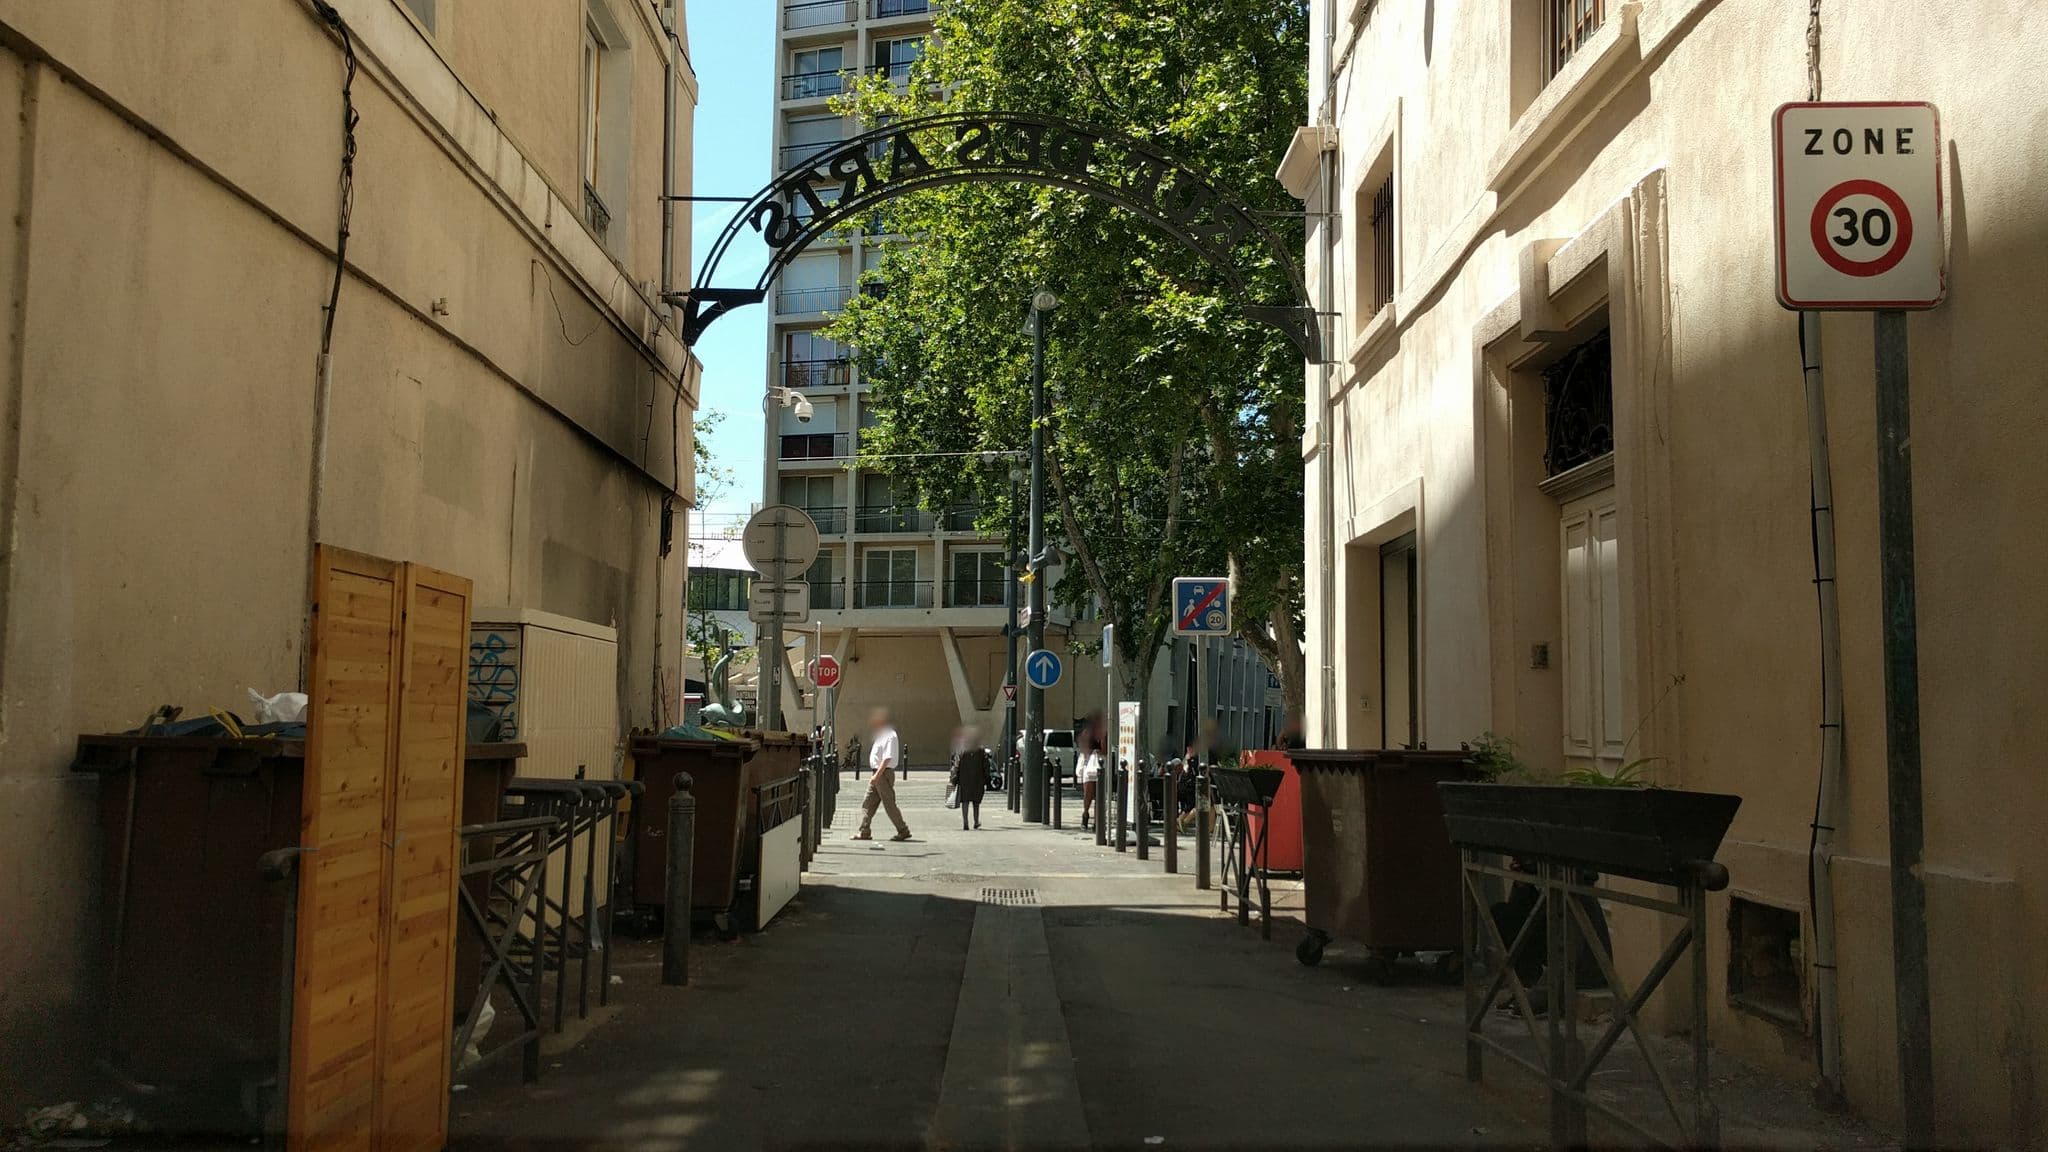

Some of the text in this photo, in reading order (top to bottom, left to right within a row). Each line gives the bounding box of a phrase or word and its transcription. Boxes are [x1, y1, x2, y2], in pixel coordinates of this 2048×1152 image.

[1804, 127, 1914, 155] ZONE
[1831, 207, 1892, 247] 30
[1210, 615, 1221, 624] 20
